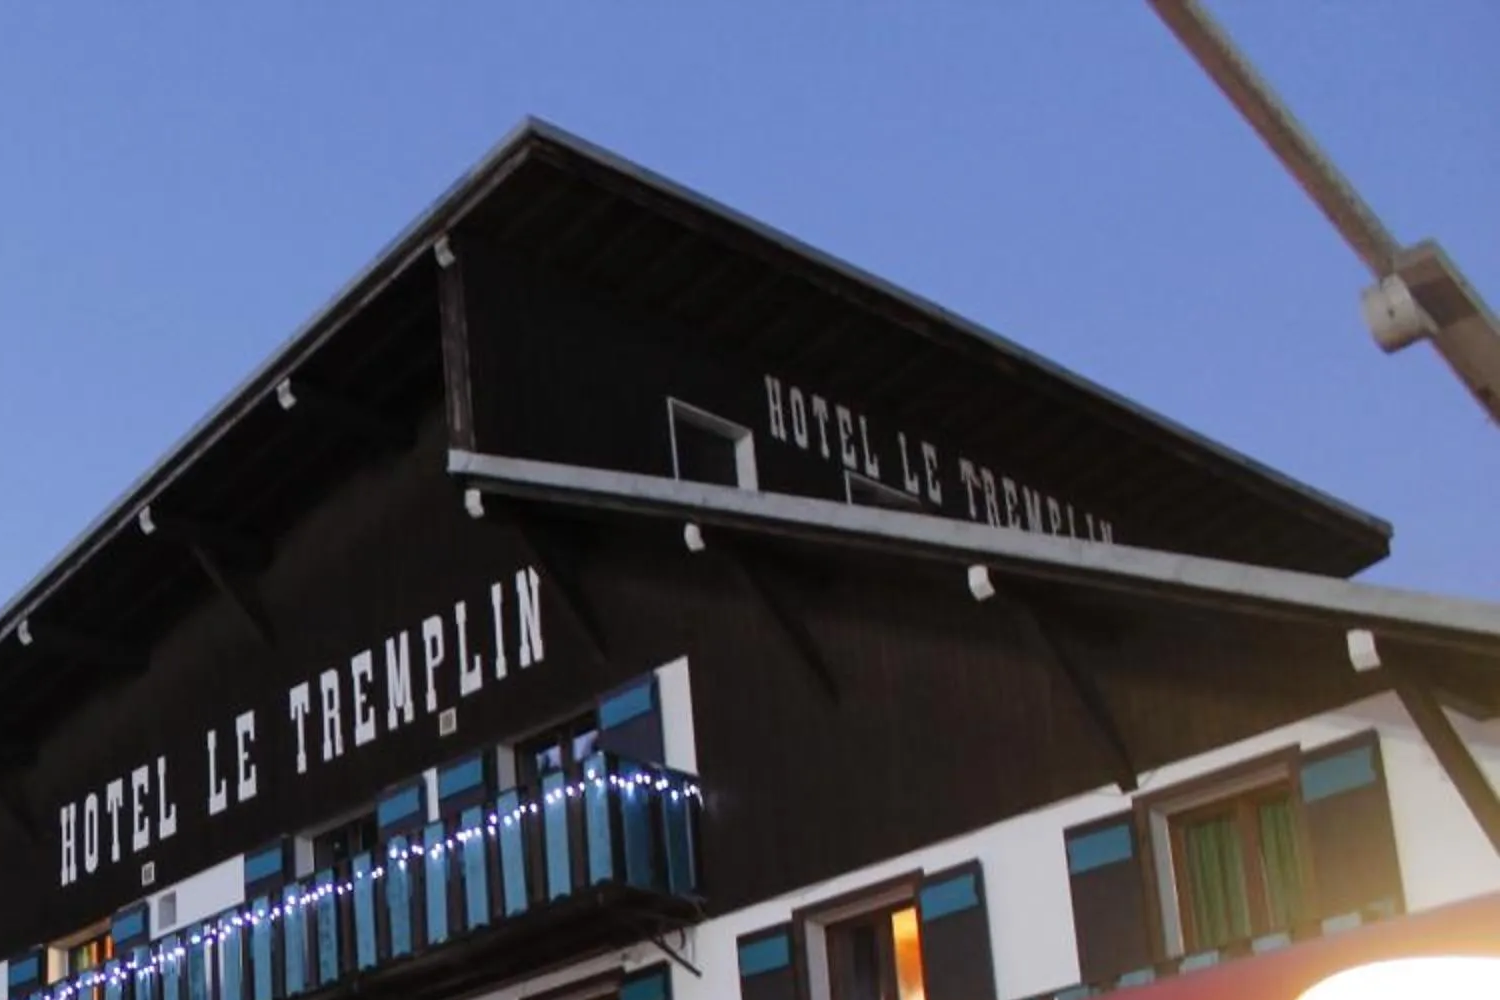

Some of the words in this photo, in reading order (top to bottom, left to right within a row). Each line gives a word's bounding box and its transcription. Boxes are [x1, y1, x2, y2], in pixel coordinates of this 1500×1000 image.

[764, 374, 880, 479] HOTEL
[898, 431, 942, 505] LE
[60, 755, 177, 886] HOTEL
[207, 709, 258, 816] LE
[290, 565, 544, 774] TREMPLIN
